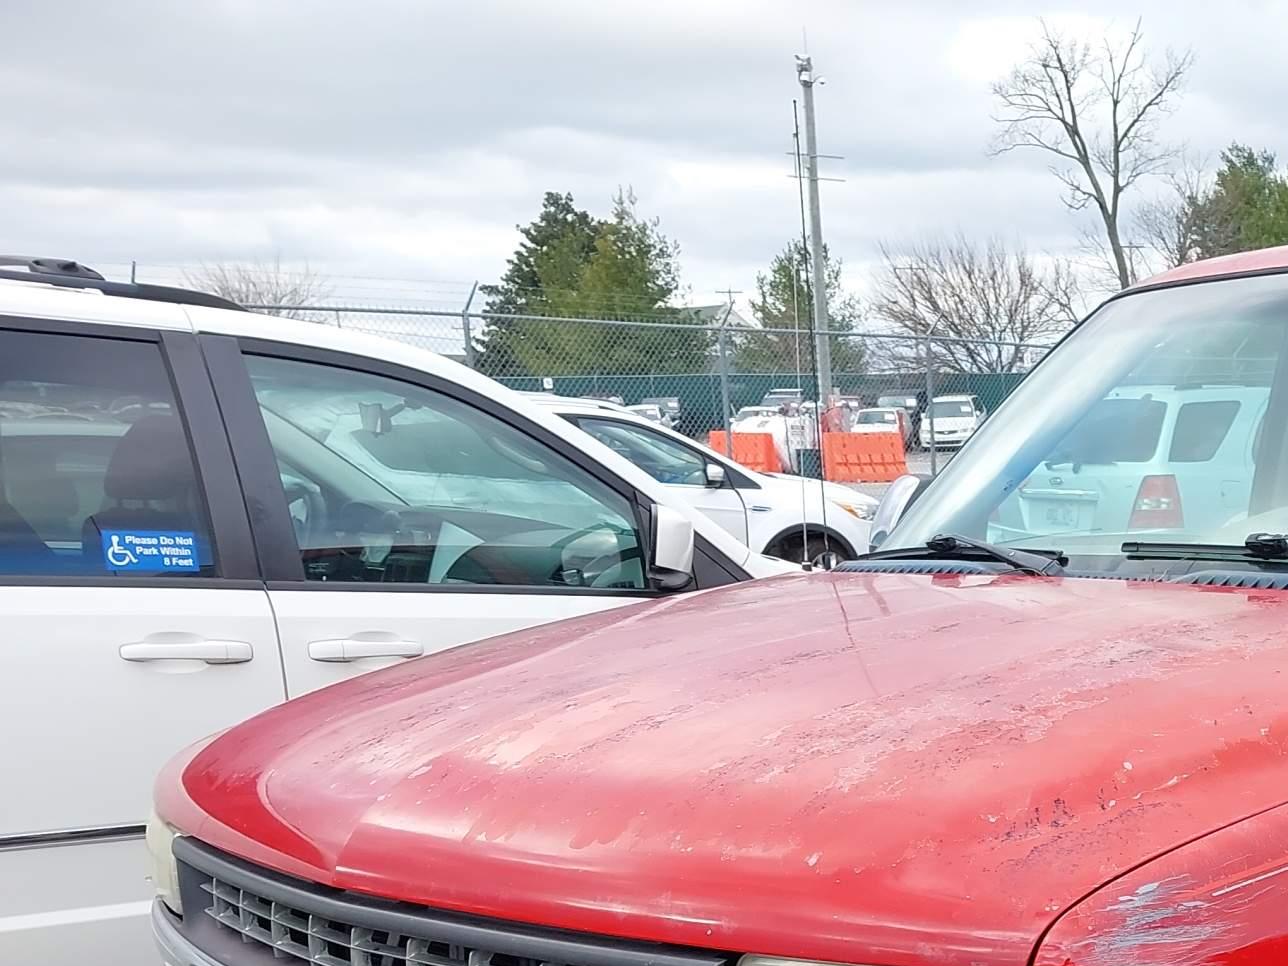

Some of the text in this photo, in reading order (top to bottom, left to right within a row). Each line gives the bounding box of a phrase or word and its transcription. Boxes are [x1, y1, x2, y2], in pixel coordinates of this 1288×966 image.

[124, 535, 193, 546] Please Do Not
[135, 546, 192, 556] Park Within
[163, 557, 194, 567] 8 Feet
